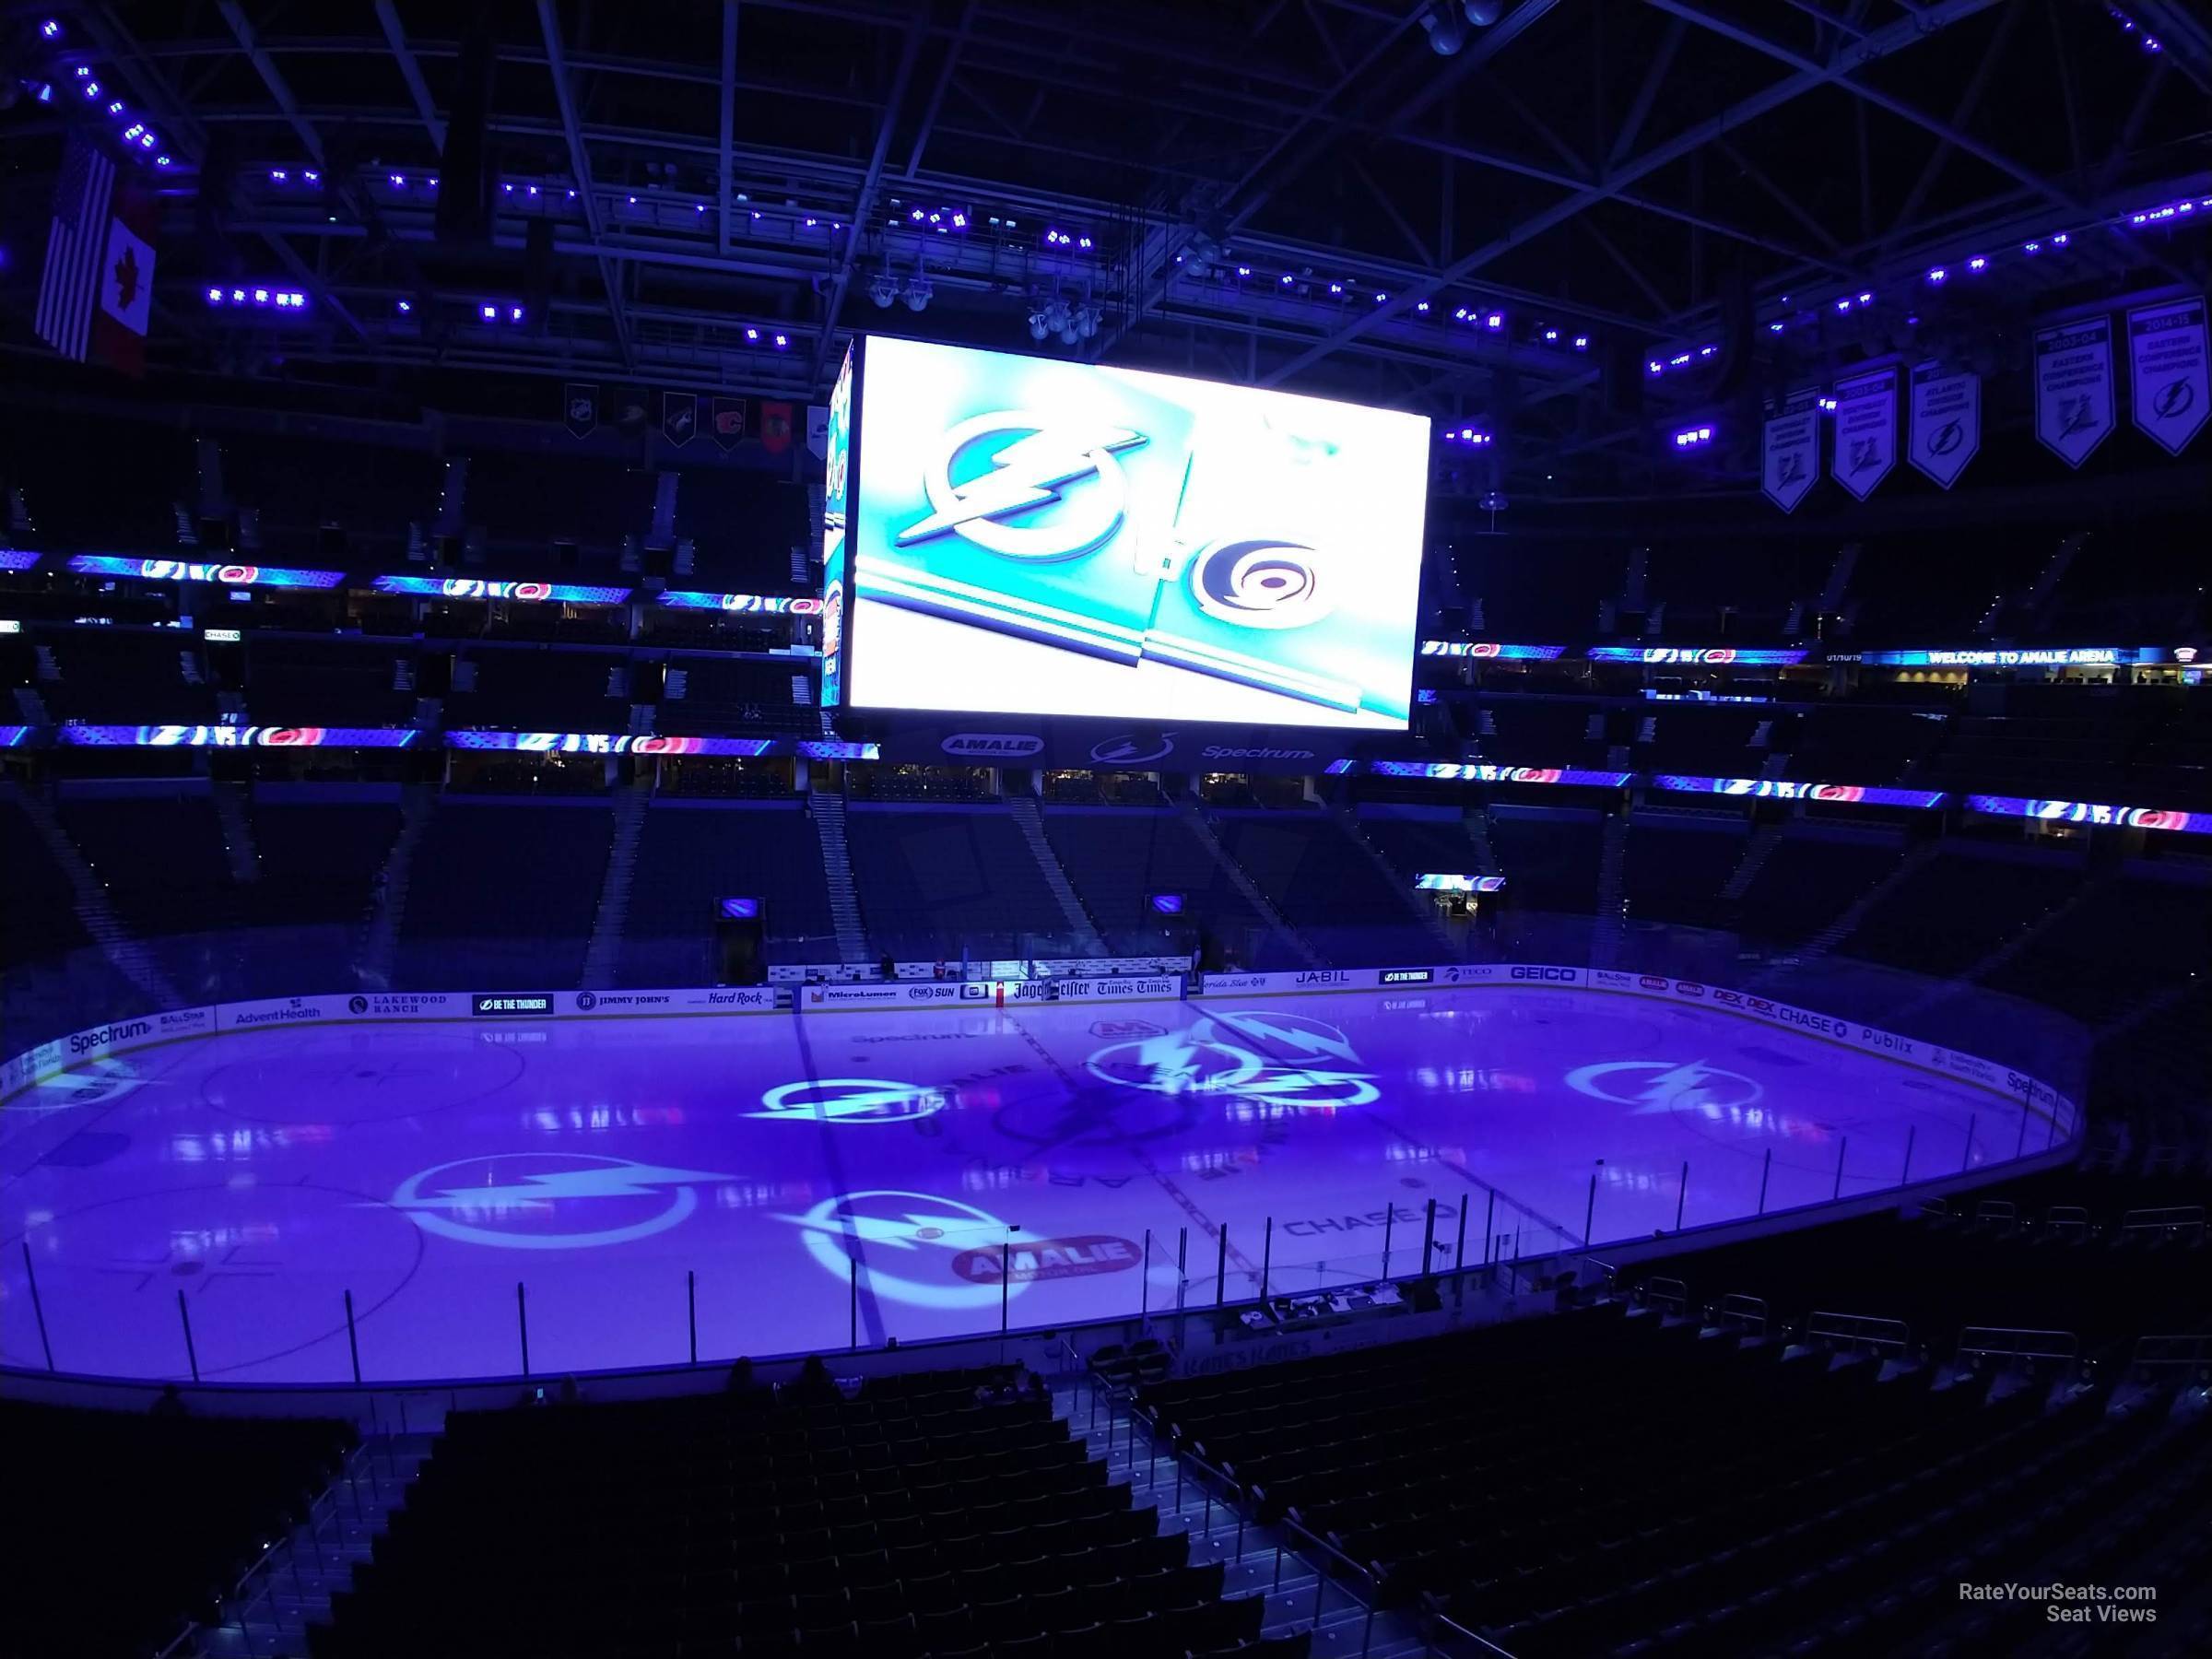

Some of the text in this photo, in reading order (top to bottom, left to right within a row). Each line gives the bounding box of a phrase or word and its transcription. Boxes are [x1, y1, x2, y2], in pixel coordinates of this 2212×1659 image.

[2146, 313, 2190, 331] 2014-15
[1929, 650, 2114, 664] WELCOME TO AMALIE ARENA
[949, 739, 1039, 751] AMALIE
[1201, 745, 1311, 759] Spectrum
[1296, 971, 1350, 982] JABIL
[1511, 967, 1576, 982] GEICO
[935, 987, 955, 997] SUN
[1097, 982, 1134, 995] Times
[1136, 981, 1172, 994] Times
[373, 995, 447, 1004] LAKEWOOD
[599, 995, 670, 1006] JIMMY JOHN'S
[709, 992, 763, 1005] Hard Rock
[1714, 989, 1743, 1005] DEX
[373, 1005, 419, 1014] RANCH
[493, 999, 547, 1010] BE THE THUNDER
[1747, 997, 1775, 1012] DEX
[1779, 1007, 1831, 1033] CHASE
[70, 1021, 147, 1055] Spectrum
[851, 1033, 969, 1043] Spectrum
[1862, 1029, 1912, 1054] Publix
[2007, 1072, 2054, 1104] Spectrum
[1283, 1208, 1422, 1237] CHASE
[971, 1241, 1133, 1276] AMALIE
